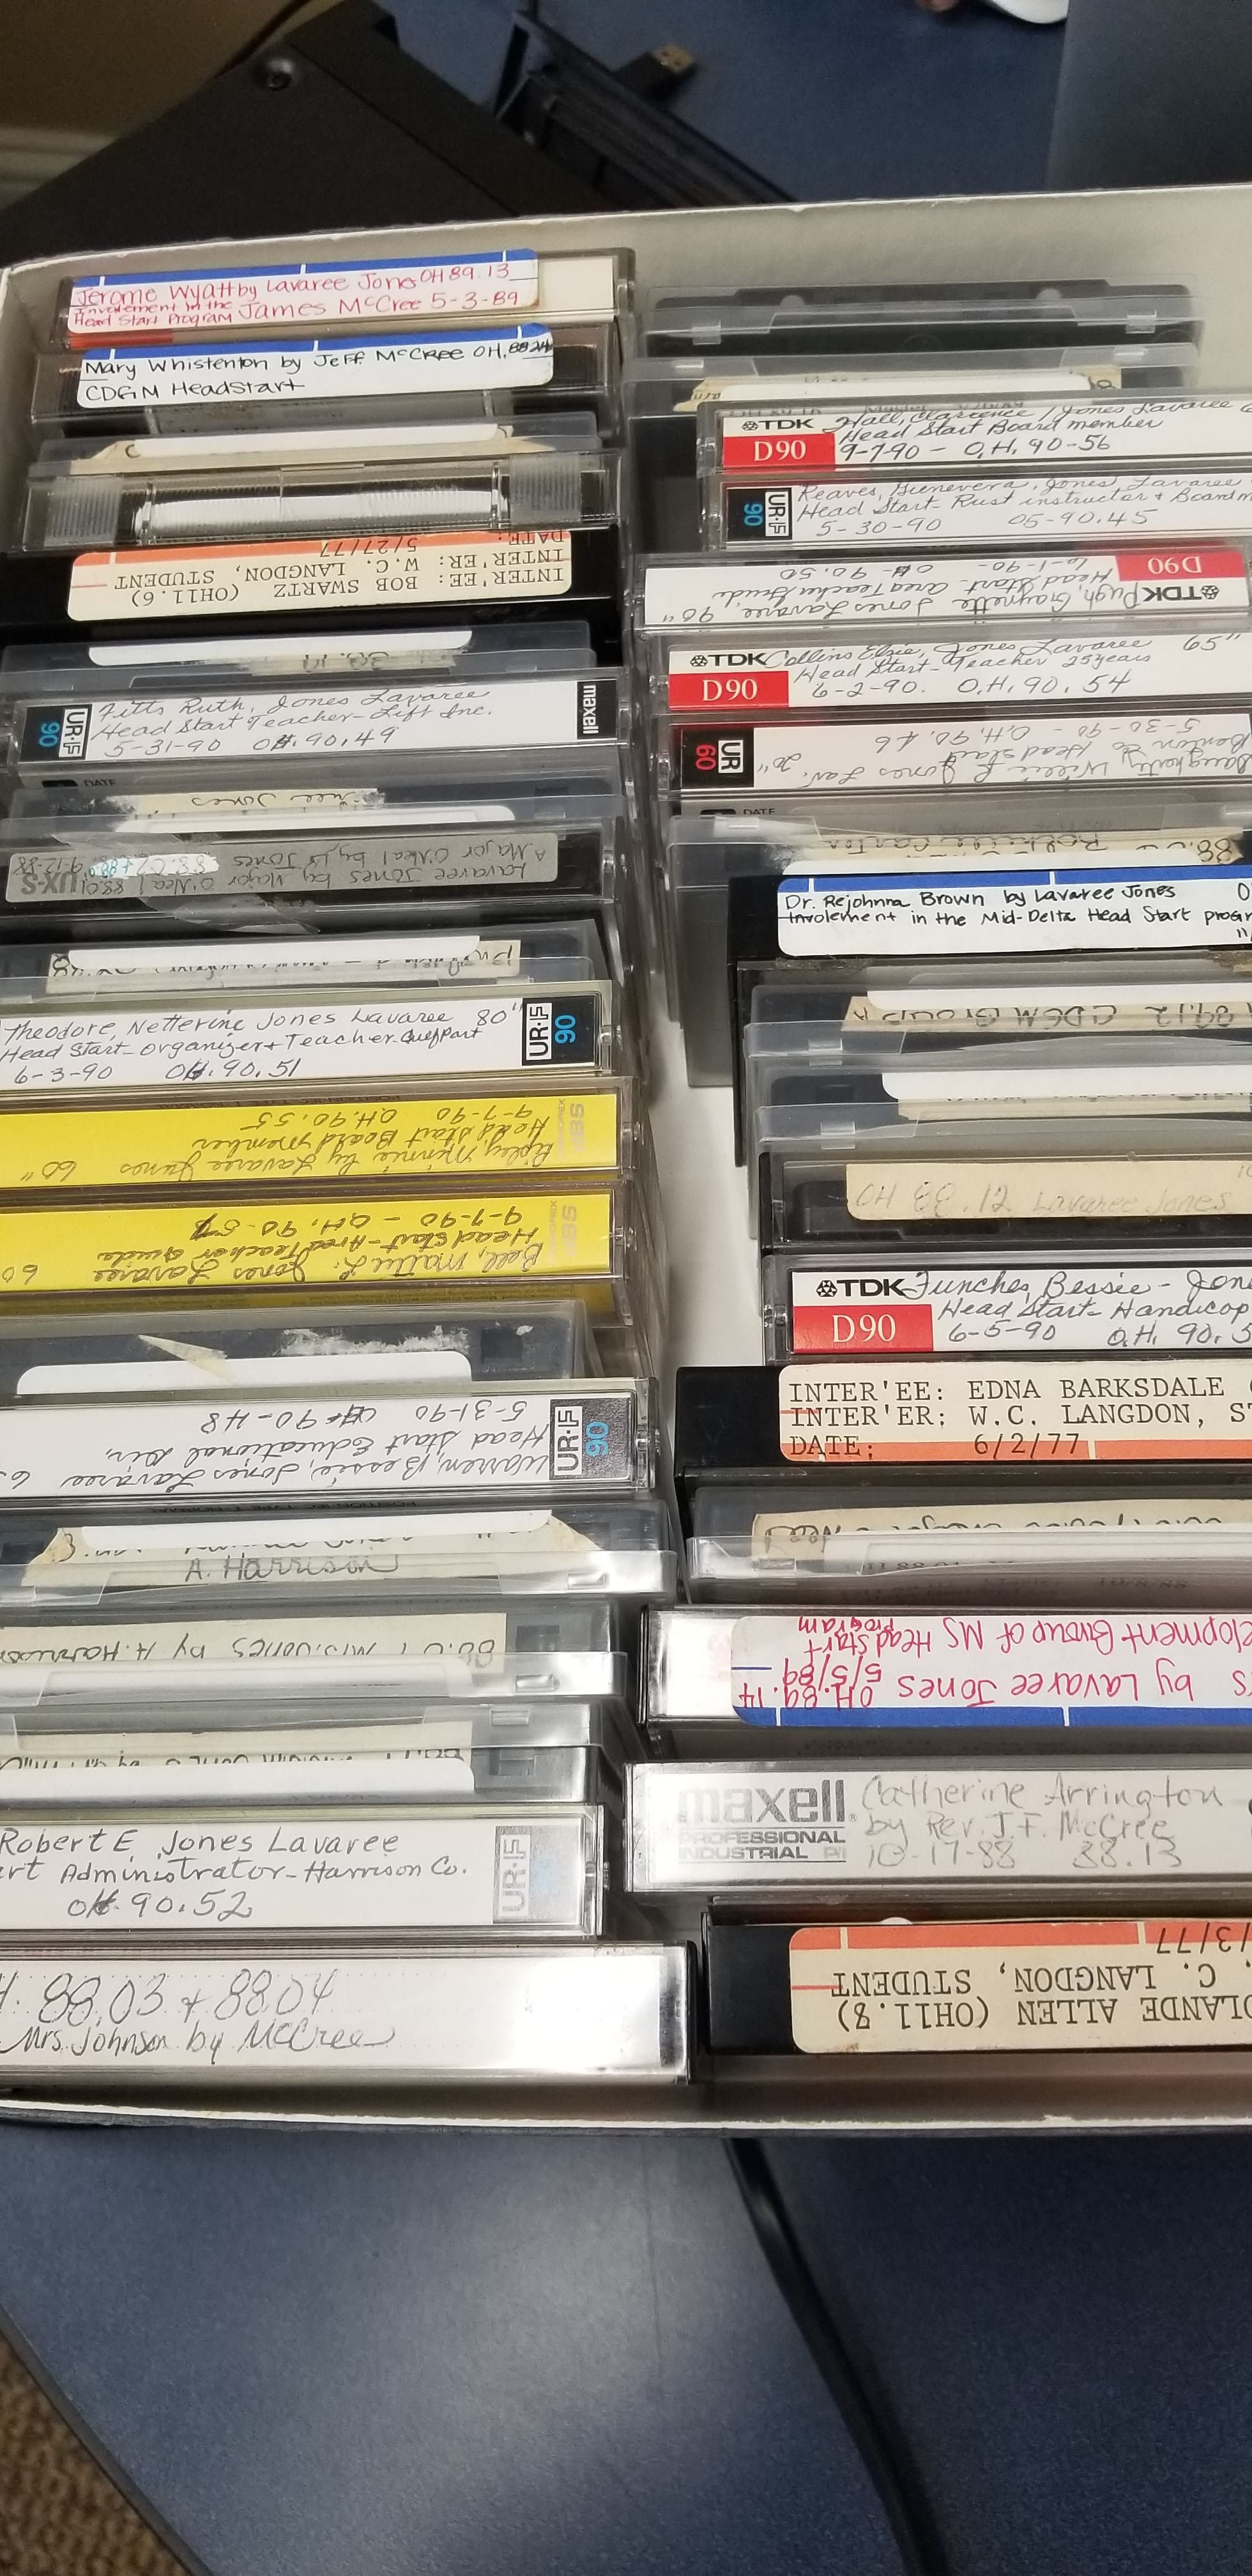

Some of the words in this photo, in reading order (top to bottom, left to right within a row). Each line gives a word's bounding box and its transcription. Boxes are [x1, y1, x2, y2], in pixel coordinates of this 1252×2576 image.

[77, 288, 157, 306] Jerome
[170, 282, 234, 303] Wyatt
[238, 280, 257, 301] by
[266, 276, 349, 292] Lavaree
[238, 302, 326, 320] James
[431, 291, 518, 310] 5-3-89
[74, 313, 111, 327] Head
[119, 314, 158, 327] Start
[86, 361, 137, 381] Mary
[148, 356, 268, 373] Whistenton
[281, 356, 302, 374] by
[86, 385, 160, 401] CDGM
[758, 418, 813, 431] TDK
[838, 422, 910, 445] Head
[918, 419, 982, 436] Start
[986, 419, 1057, 436] Board
[754, 440, 806, 462] D90
[744, 502, 763, 527] 90
[797, 502, 863, 522] Head
[817, 519, 942, 536] 5-30-90
[320, 538, 418, 558] 5/27/77
[438, 549, 563, 569] INTER'ER:
[236, 562, 346, 582] LANGDON,
[367, 558, 419, 574] W.C.
[1147, 555, 1201, 574] D90
[114, 570, 215, 590] STUDENT
[273, 579, 359, 597] SWARTZ
[376, 576, 418, 592] BOB
[438, 568, 563, 588] INTER'EE:
[1042, 567, 1113, 589] Head
[132, 583, 239, 607] (OH11.6)
[798, 583, 883, 601] Teacher
[1142, 586, 1201, 602] TDK
[854, 597, 933, 617] Jones
[708, 652, 766, 667] TDK
[794, 663, 862, 684] Head
[703, 678, 758, 702] D90
[582, 684, 599, 735] maxell
[38, 723, 59, 748] 90
[91, 719, 173, 740] Head
[174, 716, 244, 734] Start
[105, 740, 222, 757] 5-31-90
[696, 744, 715, 771] 60
[721, 742, 740, 770] UR
[1024, 742, 1091, 760] Head
[303, 869, 331, 889] by
[349, 866, 422, 884] Jones
[786, 894, 815, 910] Dr.
[919, 891, 985, 907] Brown
[1004, 889, 1026, 907] by
[1035, 886, 1114, 903] Lavaree
[1121, 884, 1175, 898] Jones
[912, 910, 927, 926] in
[936, 911, 966, 926] the
[981, 908, 1076, 925] Mid-Delta
[1088, 907, 1131, 923] Head
[1143, 905, 1191, 922] Start
[256, 1013, 336, 1031] Jones
[352, 1008, 454, 1025] Lavaree
[555, 1014, 576, 1044] 90
[0, 1041, 63, 1062] Head
[15, 1063, 112, 1085] 6-3-90
[436, 1104, 532, 1125] 9-7-90
[406, 1126, 471, 1149] Start
[477, 1116, 549, 1146] Head
[452, 1227, 538, 1250] Head
[837, 1278, 905, 1297] TDK
[1042, 1271, 1151, 1300] Bessie
[937, 1297, 1013, 1320] Head
[832, 1314, 896, 1343] D90
[949, 1319, 1056, 1342] 6-5-90
[789, 1380, 943, 1403] INTER'EE:
[968, 1378, 1041, 1400] EDNA
[1059, 1377, 1224, 1399] BARKSDALE
[415, 1399, 527, 1423] 5-31-90
[790, 1404, 945, 1429] INTER'ER:
[968, 1406, 1036, 1426] W.C.
[1062, 1403, 1203, 1429] LANGDON,
[386, 1430, 461, 1456] Start
[475, 1423, 549, 1451] Head
[585, 1421, 609, 1457] 90
[974, 1432, 1079, 1460] 6/2/77
[61, 1469, 204, 1491] Lavaree
[214, 1463, 300, 1486] Jones
[877, 1629, 931, 1659] Head
[943, 1616, 983, 1650] MS
[996, 1622, 1024, 1653] of
[1032, 1620, 1113, 1655] Group
[804, 1632, 869, 1665] Start
[783, 1653, 882, 1692] 5/5/89
[1156, 1658, 1193, 1702] by
[898, 1675, 996, 1708] Jones
[1011, 1672, 1138, 1701] Lavaree
[678, 1779, 845, 1823] maxell
[862, 1774, 1025, 1811] Catherine
[1045, 1772, 1223, 1820] Arrington
[0, 1827, 107, 1856] Robert
[114, 1828, 139, 1852] E
[162, 1829, 253, 1856] Jones
[268, 1825, 399, 1855] Lavaree
[678, 1830, 846, 1844] PROFESSIONAL
[865, 1813, 908, 1850] by
[1060, 1809, 1175, 1841] McCree
[678, 1846, 808, 1860] INDUSTRIAL
[832, 1968, 970, 1997] STUDENT
[1000, 1962, 1156, 1993] LANGDON,
[838, 1996, 989, 2032] (OH11.8)
[1017, 1998, 1118, 2026] ALLEN
[72, 2027, 169, 2057] Johnson
[187, 2020, 224, 2064] by
